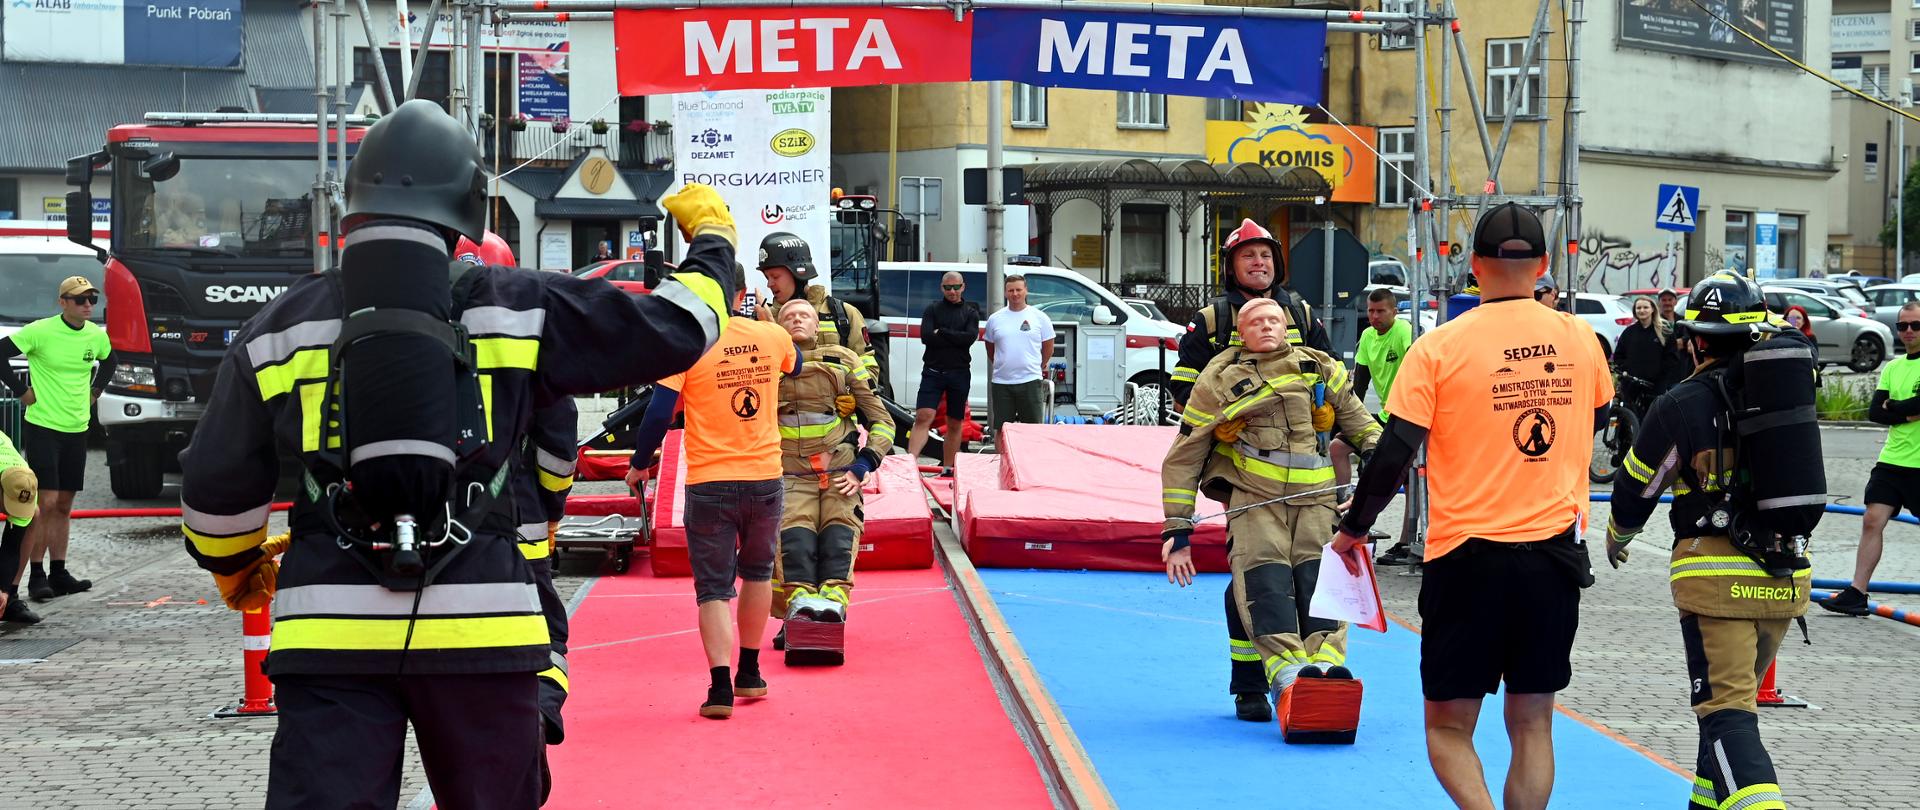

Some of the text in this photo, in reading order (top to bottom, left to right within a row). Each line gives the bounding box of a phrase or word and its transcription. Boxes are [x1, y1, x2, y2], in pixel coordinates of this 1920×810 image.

[147, 5, 231, 21] Punkt Pobrań
[683, 18, 903, 76] META
[1037, 18, 1254, 85] META
[766, 91, 825, 102] podkarpacie
[678, 100, 744, 111] Blue Diamond
[691, 151, 735, 160] DEZAMET
[1259, 150, 1335, 167] KOMIS
[683, 169, 825, 187] BORGWARNER
[785, 205, 816, 213] AGENCJA
[785, 213, 807, 221] WALDI
[205, 285, 289, 303] SCAN
[724, 344, 759, 357] SĘDZIA
[1504, 344, 1557, 361] SĘDZIA
[1492, 378, 1572, 394] 6 MISTRZOSTWA POLSKI
[1530, 389, 1547, 397] TYTUŁ
[1493, 396, 1572, 412] NAJTWARDSZEGO STRAŻAKA
[1730, 582, 1801, 600] ŚWIERCZYK
